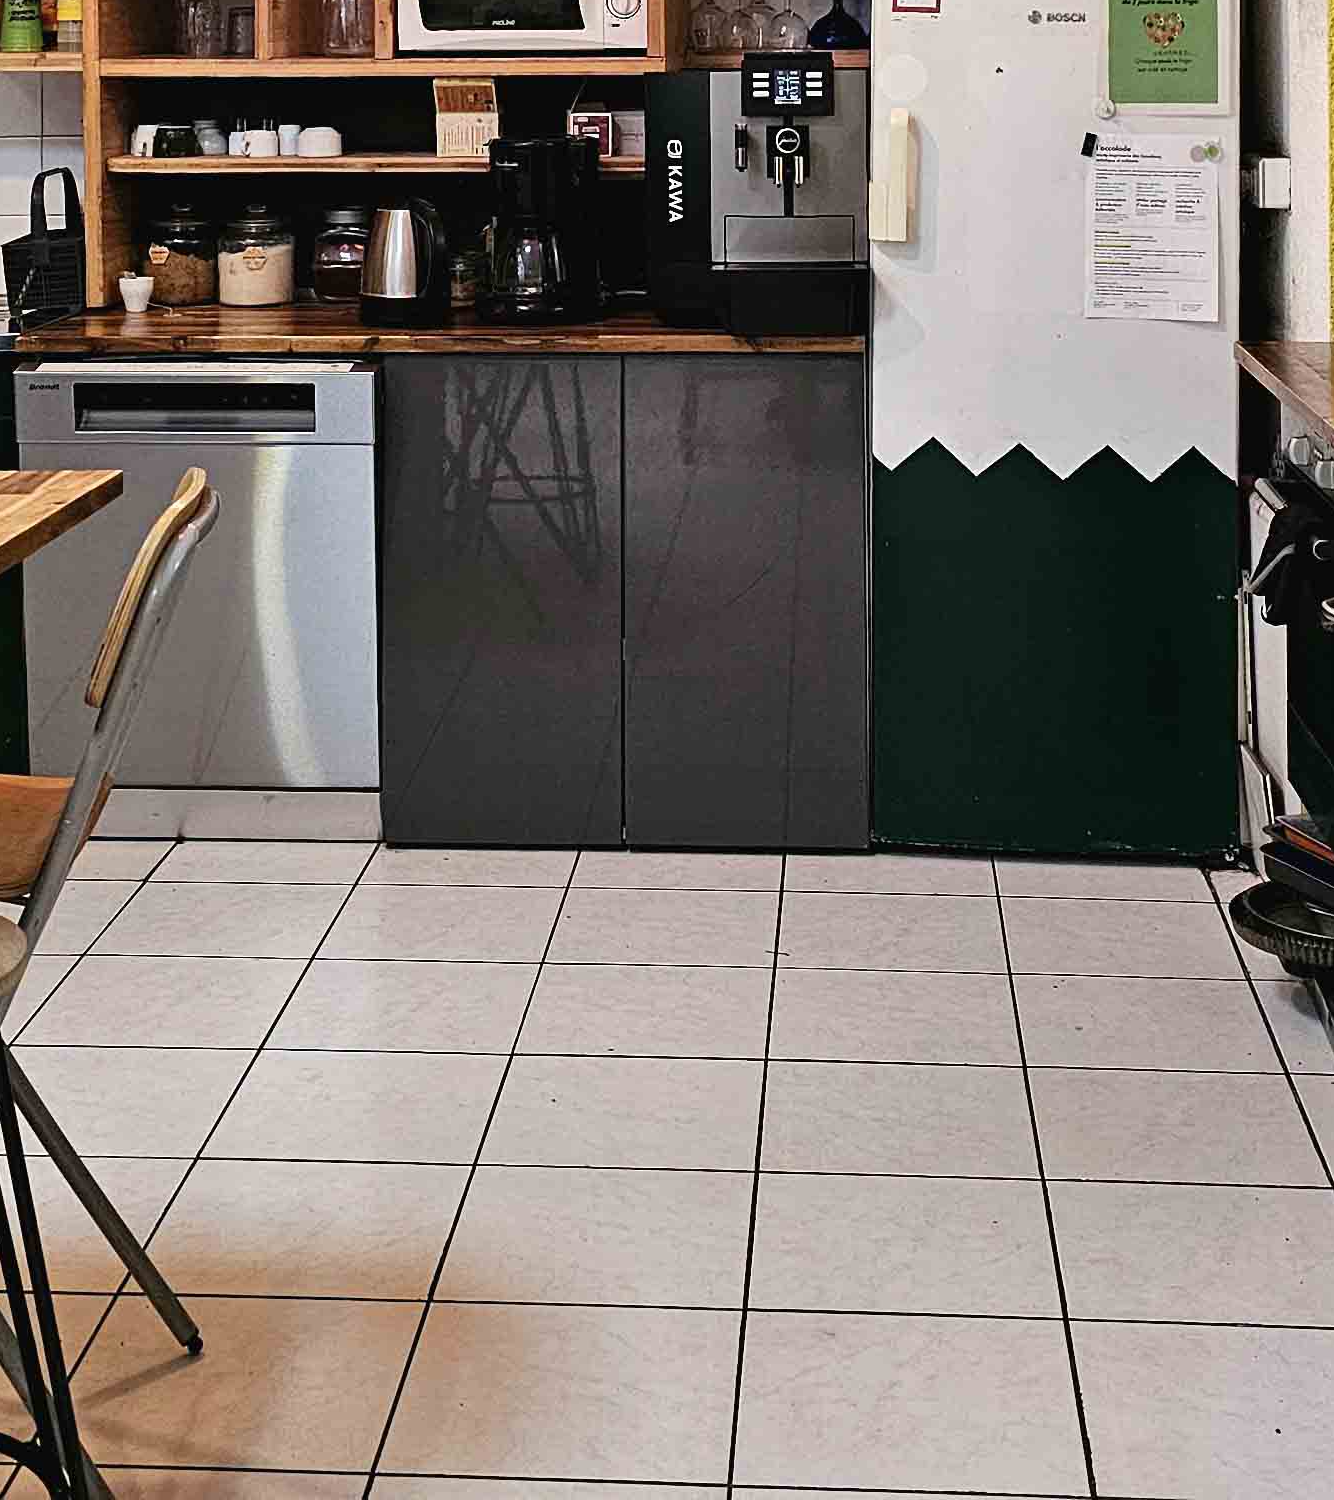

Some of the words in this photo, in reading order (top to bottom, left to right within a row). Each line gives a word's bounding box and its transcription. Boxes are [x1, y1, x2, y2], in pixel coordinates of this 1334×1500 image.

[1047, 13, 1087, 23] BOSCH
[667, 165, 684, 223] KAWA
[29, 382, 60, 391] Brandt
